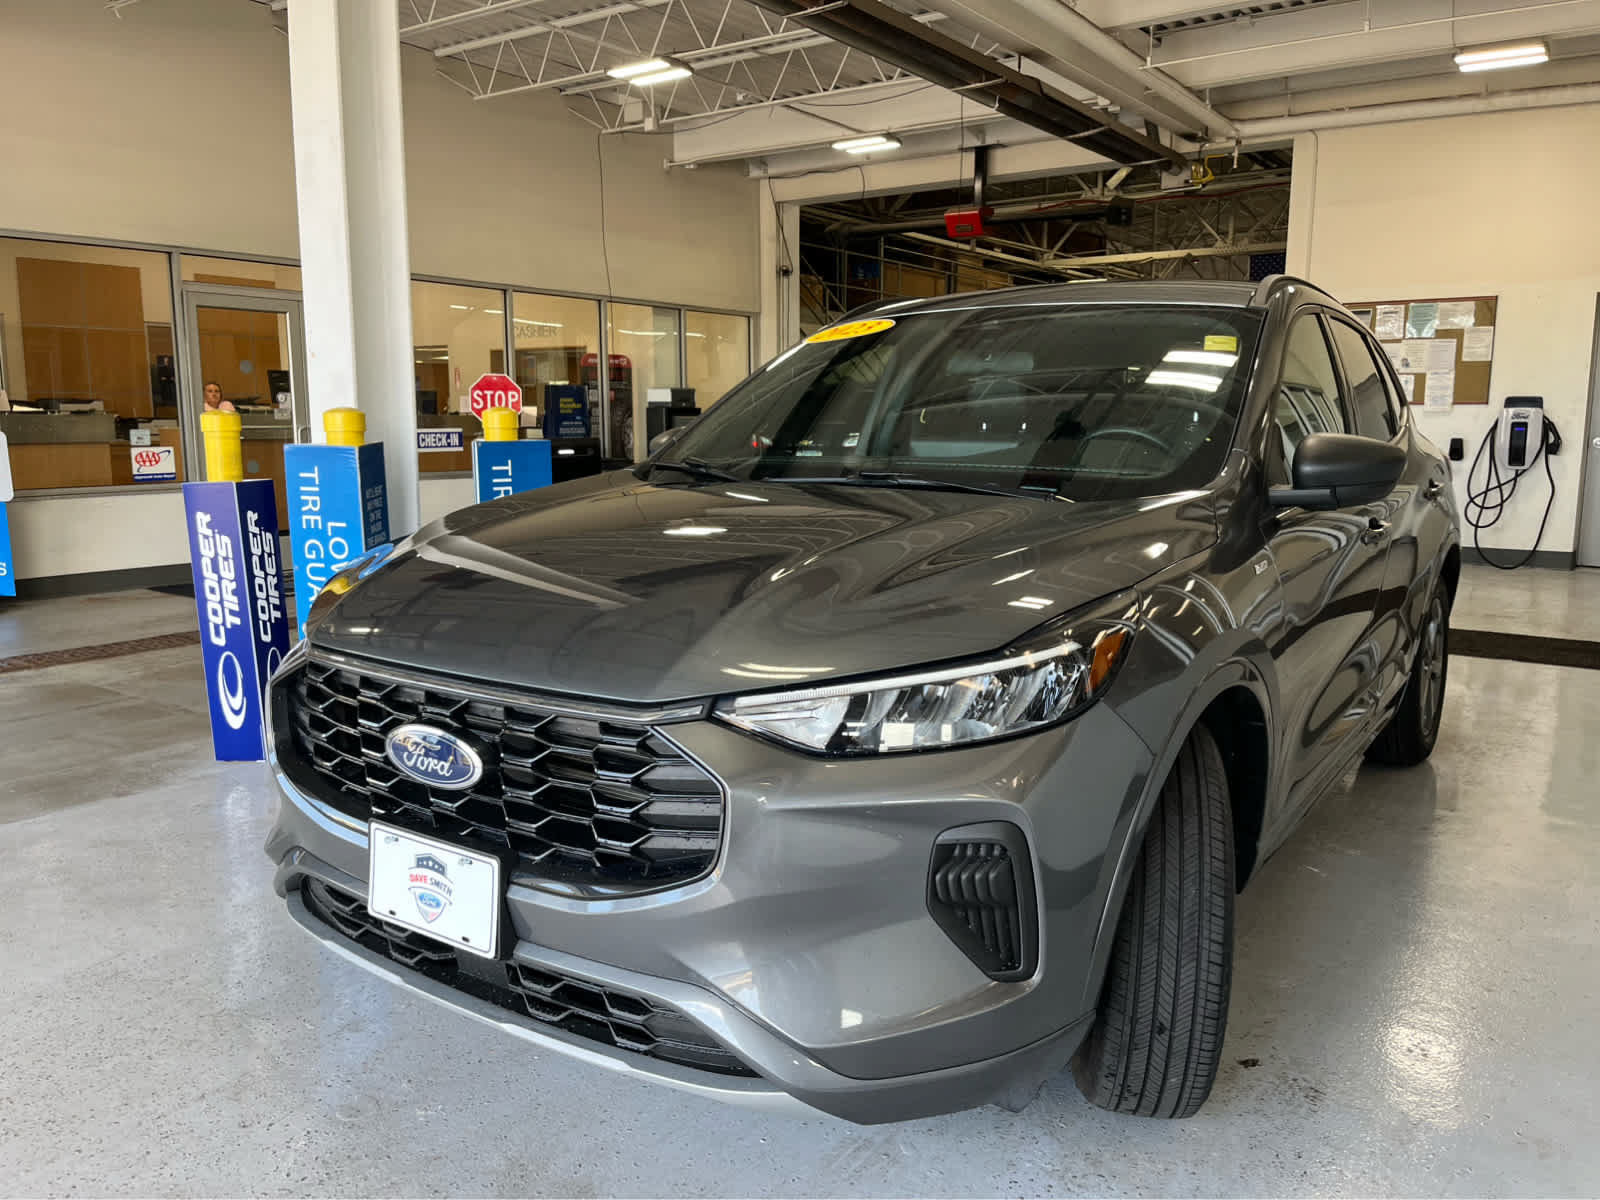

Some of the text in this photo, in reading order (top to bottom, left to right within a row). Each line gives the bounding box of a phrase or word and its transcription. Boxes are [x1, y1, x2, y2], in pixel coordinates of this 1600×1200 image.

[472, 390, 519, 411] STOP
[135, 451, 161, 467] AAA
[418, 433, 459, 449] CHECK-IN
[299, 466, 322, 530] TIRE
[196, 511, 227, 647] COOPER
[215, 530, 241, 629] TIRES
[246, 510, 272, 643] COOPER
[262, 529, 282, 624] TIRES
[402, 737, 454, 778] Ford
[429, 876, 453, 897] SMITH
